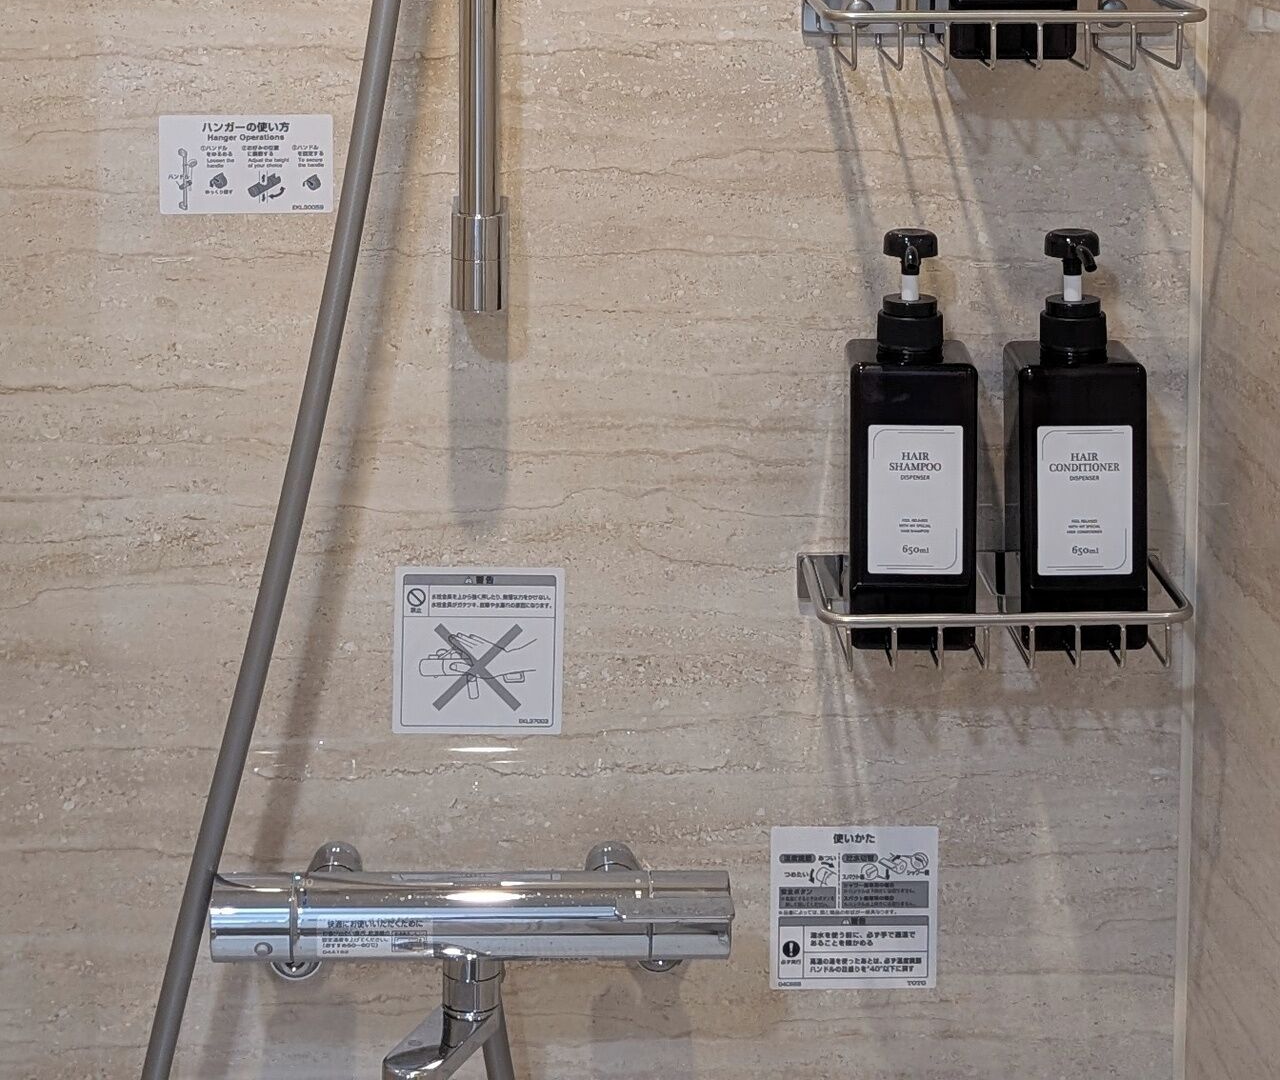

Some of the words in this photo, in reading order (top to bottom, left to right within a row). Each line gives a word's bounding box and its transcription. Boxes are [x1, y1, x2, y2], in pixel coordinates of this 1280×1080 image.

[202, 122, 290, 132] ハンガーの使い方
[902, 452, 929, 461] HAIR
[1070, 453, 1098, 461] HAIR
[889, 463, 942, 471] SHAMPOO
[1049, 463, 1120, 472] CONDITIONER
[902, 545, 929, 554] 650ml
[1072, 546, 1099, 556] 650ml
[833, 834, 876, 844] 使いかた
